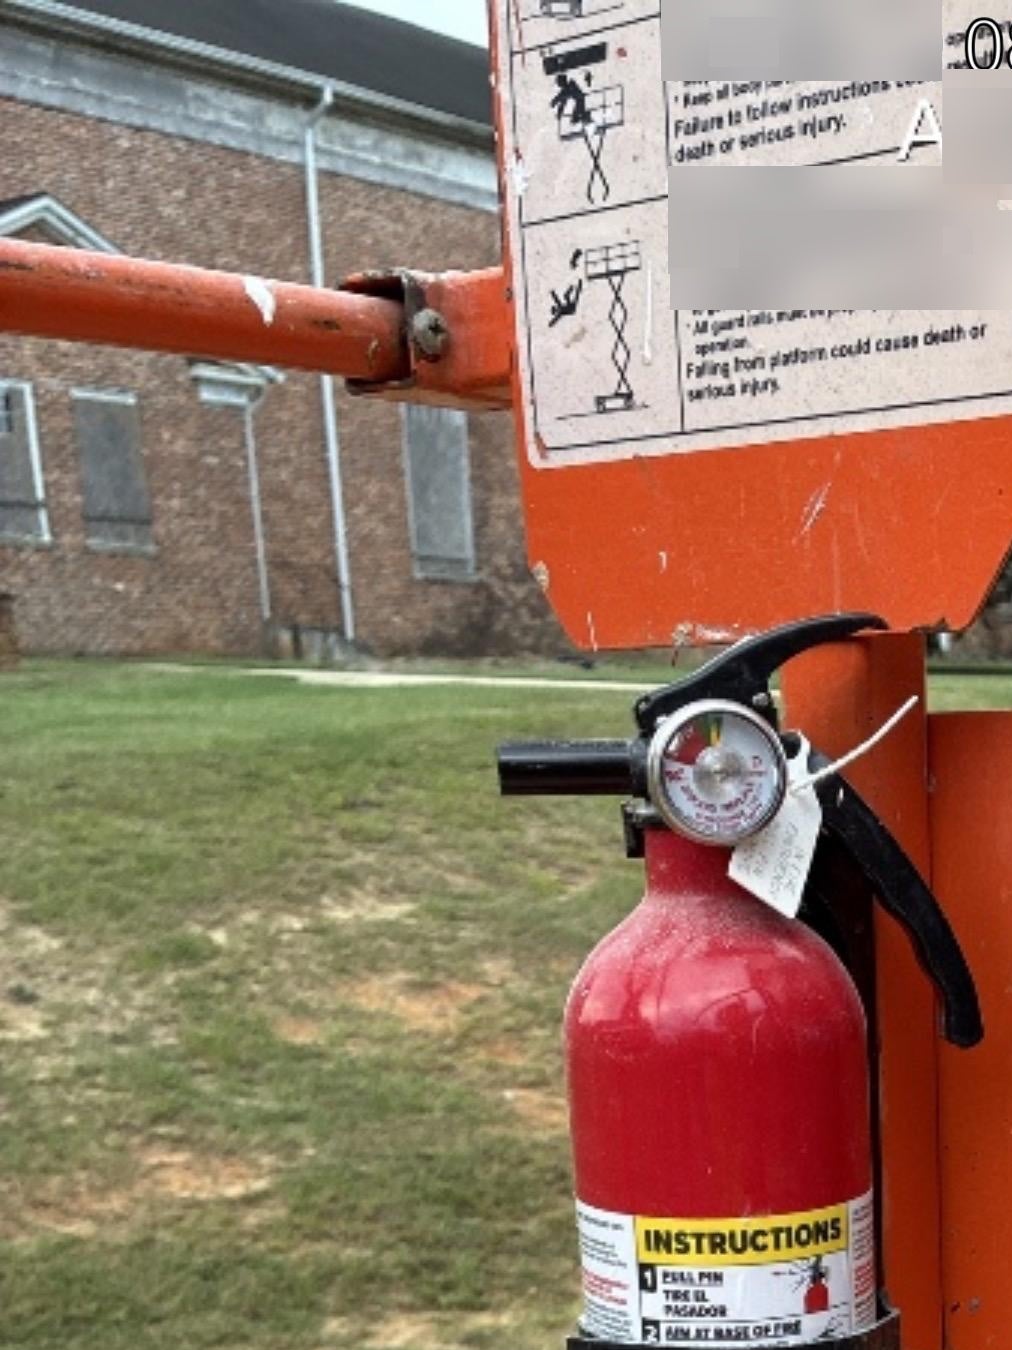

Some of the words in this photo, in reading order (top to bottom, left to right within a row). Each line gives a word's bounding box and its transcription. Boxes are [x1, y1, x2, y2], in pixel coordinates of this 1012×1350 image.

[675, 113, 724, 138] Failure
[728, 109, 741, 125] to
[746, 98, 791, 119] follow
[797, 80, 890, 110] instructions
[675, 141, 714, 163] death
[720, 138, 735, 153] or
[739, 123, 795, 150] serious
[800, 113, 847, 138] injury.
[692, 319, 709, 336] All
[712, 314, 745, 335] guard
[749, 311, 774, 328] rails
[686, 361, 730, 380] Falling
[734, 355, 765, 373] from
[769, 346, 828, 371] platform
[830, 338, 871, 360] could
[875, 335, 919, 353] cause
[923, 323, 966, 346] death
[969, 323, 988, 339] or
[687, 382, 736, 402] serious
[643, 1218, 842, 1255] INSTRUCTIONS
[642, 1270, 653, 1289] 1
[662, 1271, 695, 1285] PULL
[698, 1271, 724, 1285] PIN
[662, 1289, 691, 1303] TIRE
[663, 1303, 728, 1318] PASADOR
[666, 1325, 691, 1341] AIM
[695, 1327, 711, 1340] AT
[713, 1326, 750, 1340] BASE
[774, 1320, 802, 1336] FIRE
